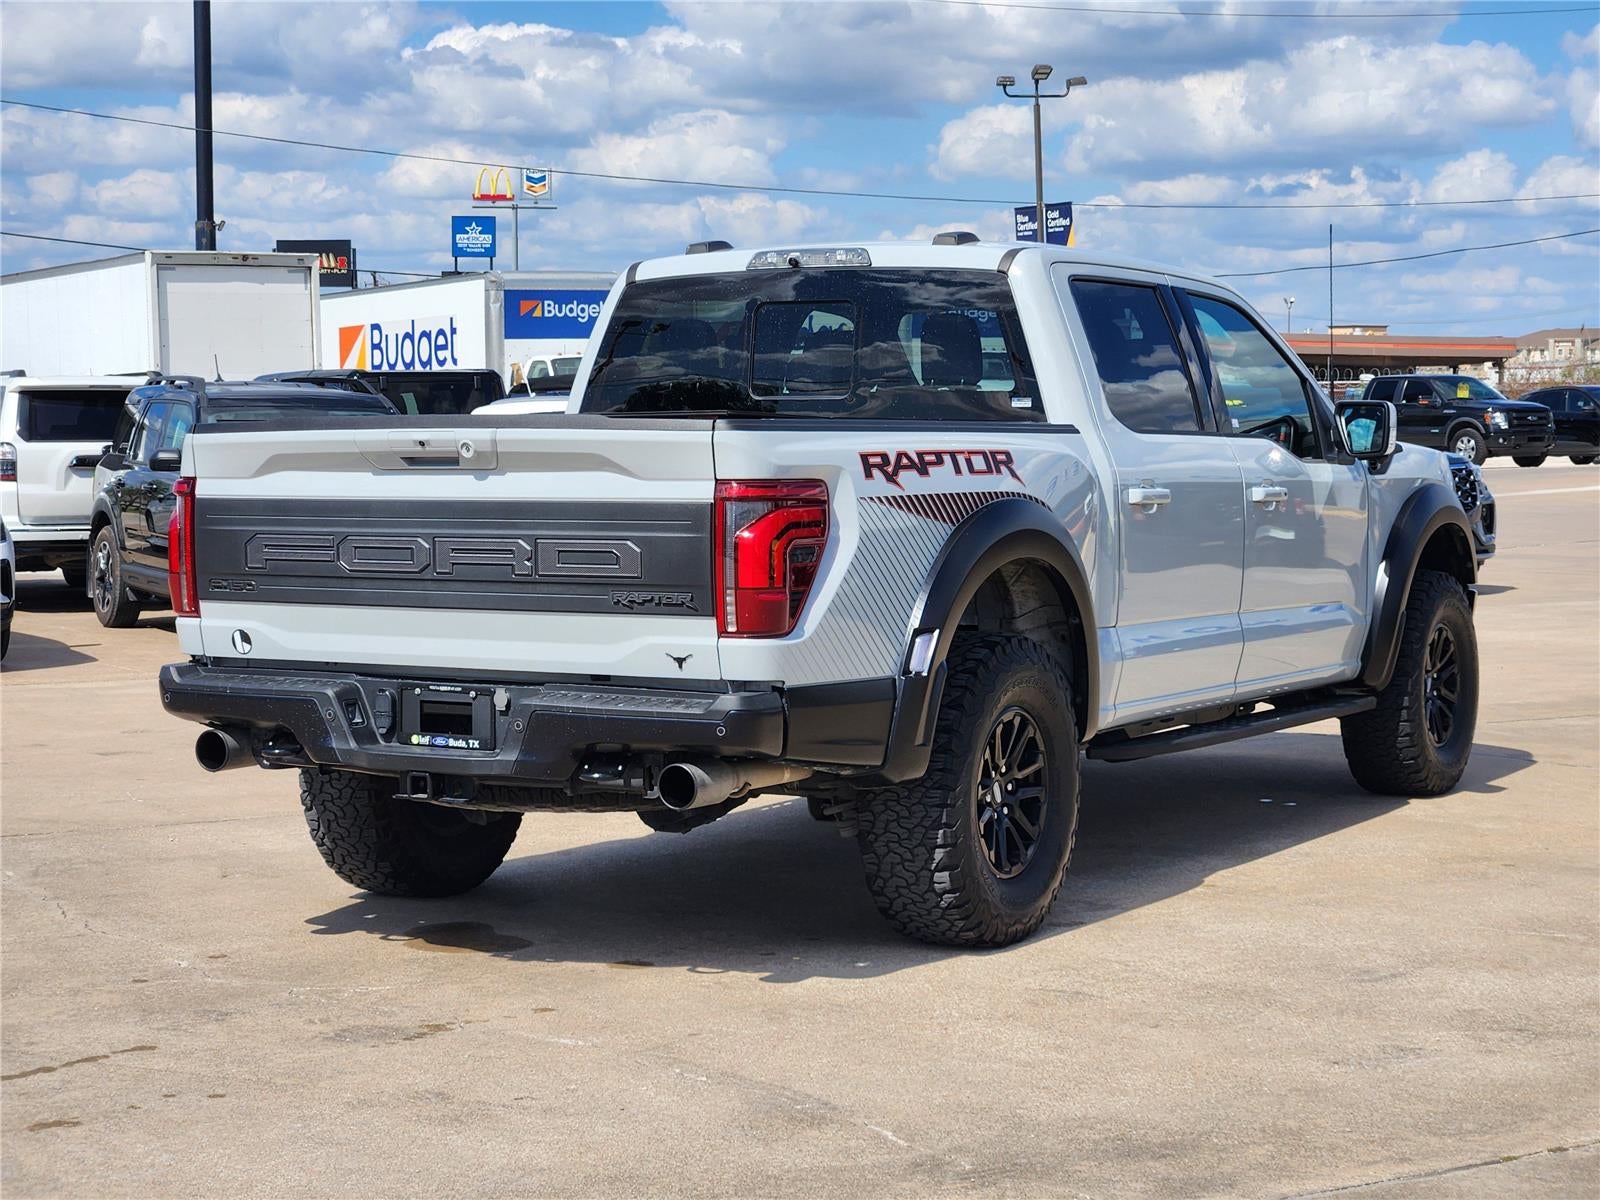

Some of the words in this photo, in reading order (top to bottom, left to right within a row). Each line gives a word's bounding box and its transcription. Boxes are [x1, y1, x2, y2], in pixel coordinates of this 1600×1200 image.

[1047, 210, 1059, 218] Gold
[1047, 218, 1070, 227] Certified
[370, 316, 458, 371] Budget
[858, 449, 1026, 492] RAPTOR
[244, 532, 643, 580] FORD
[609, 589, 699, 612] RAPTOR
[468, 740, 480, 748] TX
